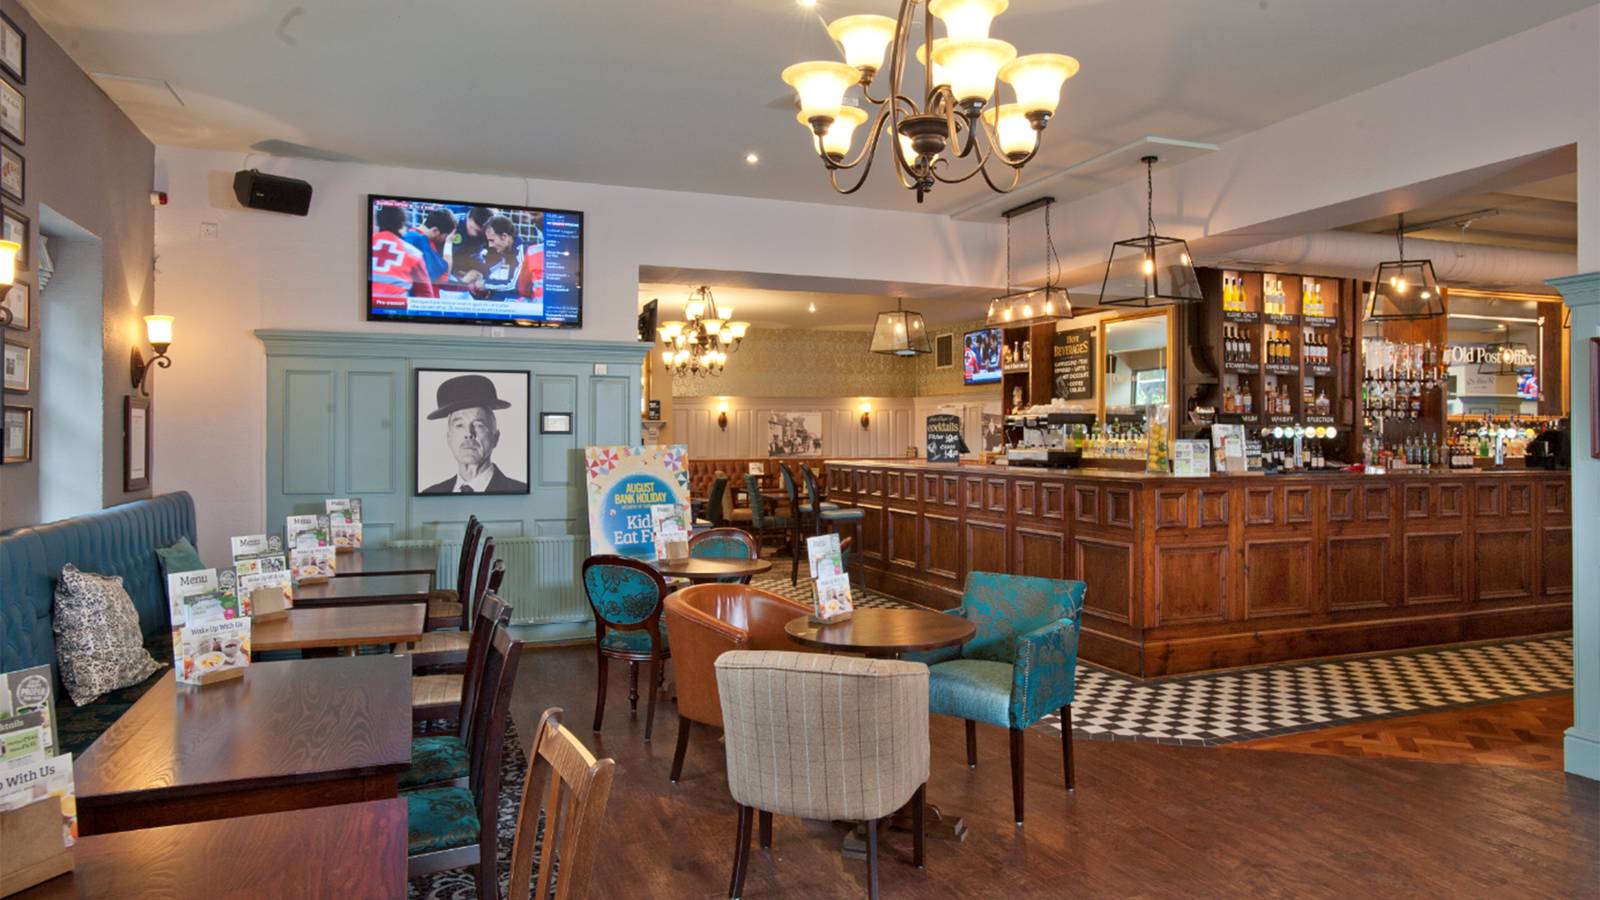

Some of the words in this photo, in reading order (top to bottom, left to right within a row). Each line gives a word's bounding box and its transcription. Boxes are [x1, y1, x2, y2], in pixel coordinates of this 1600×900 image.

[1054, 341, 1088, 356] BEVERAGES
[1452, 346, 1474, 362] Old
[1477, 347, 1501, 364] Post
[1503, 348, 1537, 365] Office
[626, 482, 655, 493] AUGUST
[614, 494, 636, 504] BANK
[637, 492, 667, 503] HOLIDAY
[627, 514, 651, 530] Kid
[614, 530, 639, 545] Eat
[180, 574, 208, 587] Menu
[191, 626, 209, 635] Wake
[210, 625, 218, 634] Up
[220, 622, 234, 631] With
[6, 769, 37, 787] With
[39, 765, 56, 777] Us
